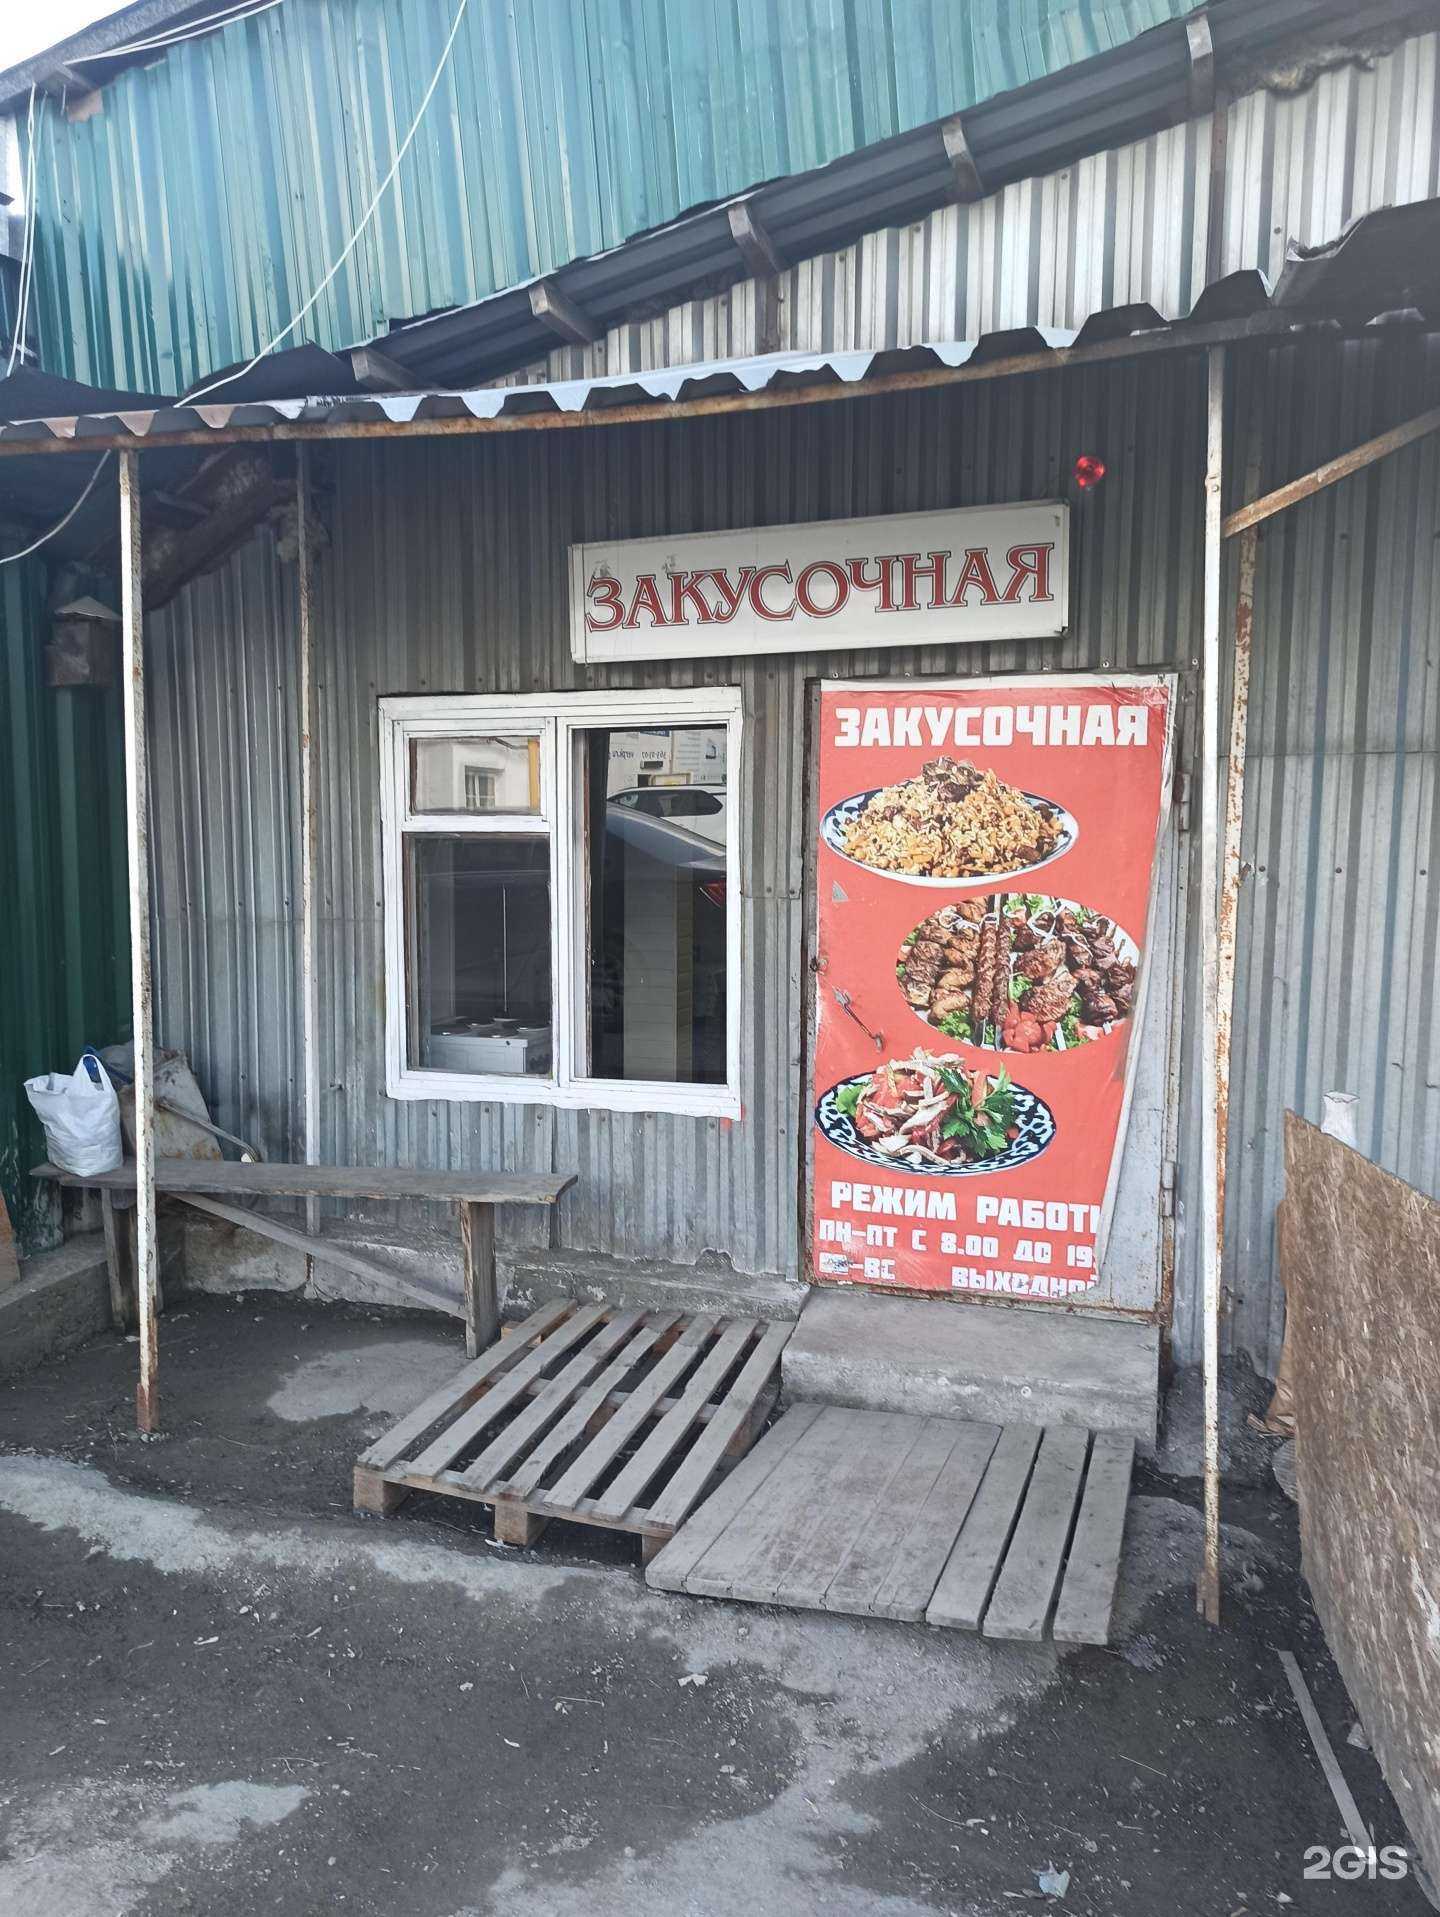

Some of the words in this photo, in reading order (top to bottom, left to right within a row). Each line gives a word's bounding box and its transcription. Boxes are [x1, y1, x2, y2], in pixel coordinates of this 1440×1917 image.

[586, 543, 1054, 633] ЗАКУСОЧНАЯ
[834, 705, 1149, 747] ЗАКУСОЧНАЯ
[831, 1180, 957, 1221] РЕЖИМ
[818, 1219, 898, 1249] ПН-ПТ
[911, 1229, 928, 1251] С
[940, 1232, 999, 1259] 8.00
[1012, 1239, 1052, 1264] ДО
[818, 1251, 896, 1281] -ВС
